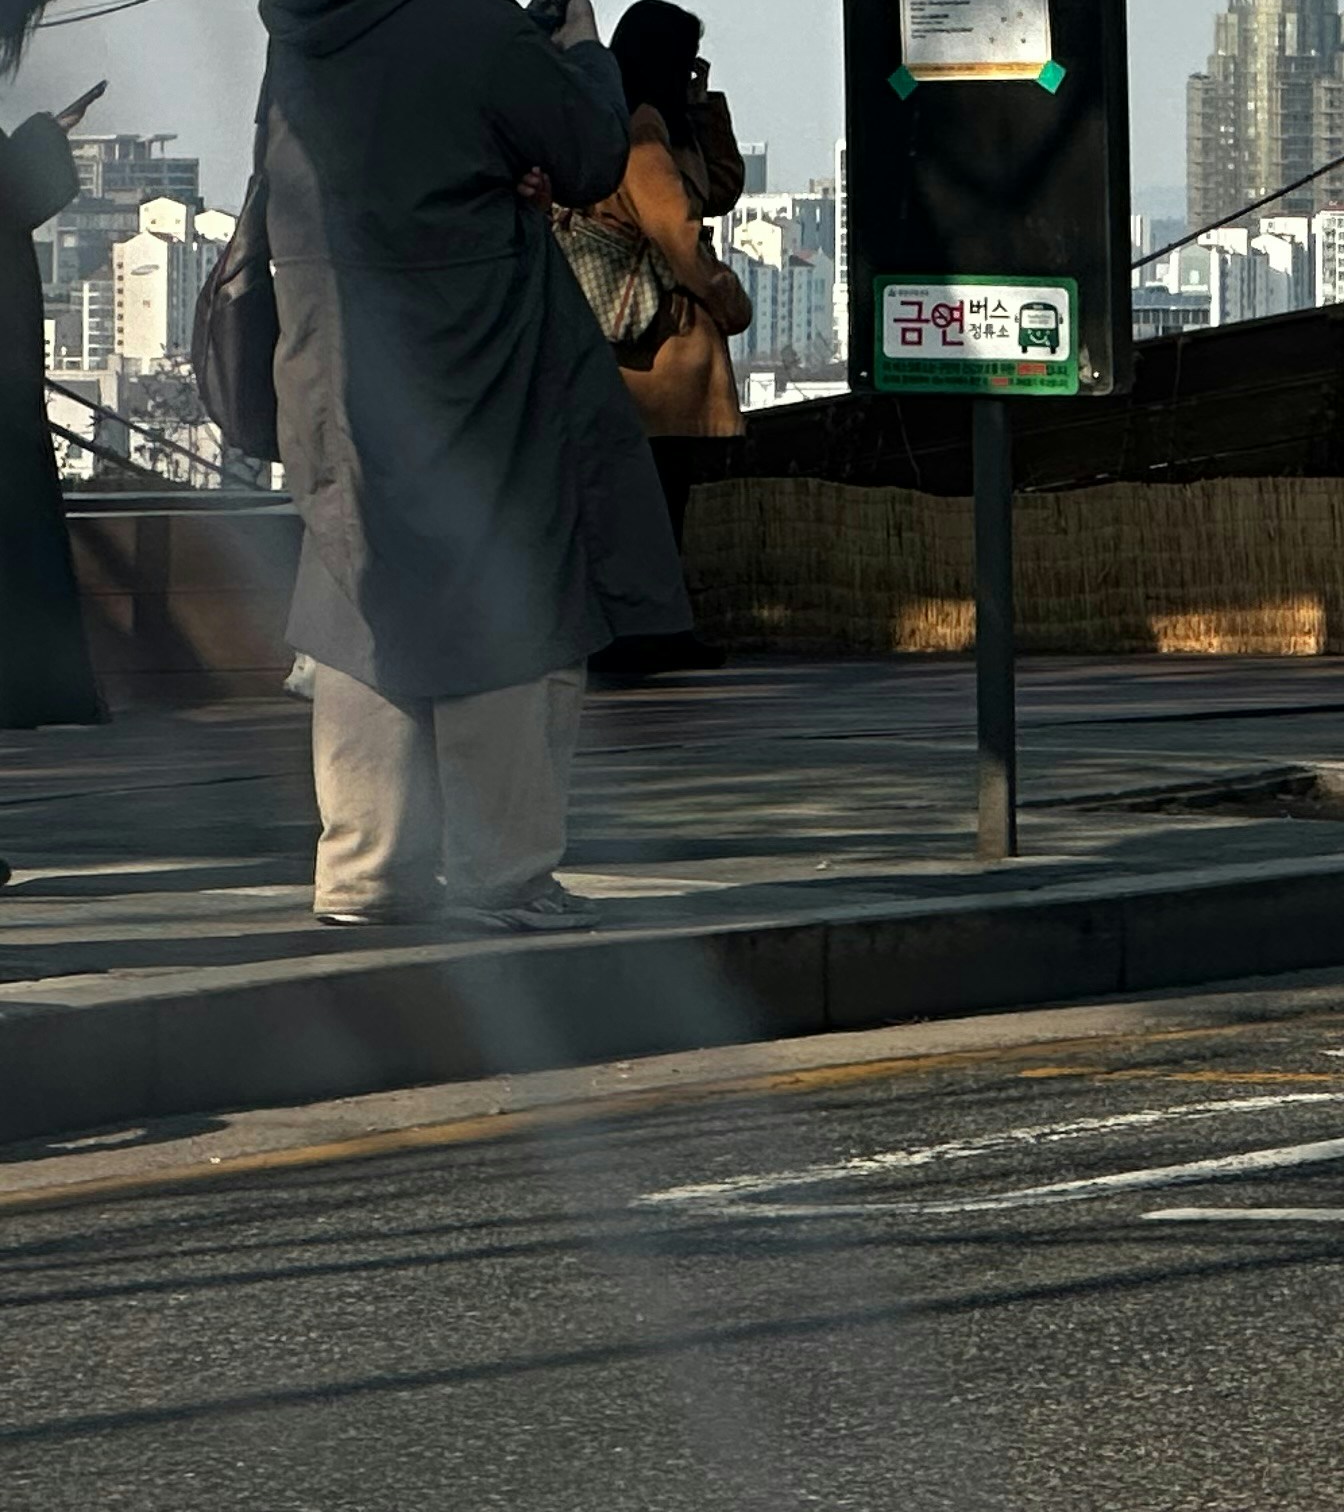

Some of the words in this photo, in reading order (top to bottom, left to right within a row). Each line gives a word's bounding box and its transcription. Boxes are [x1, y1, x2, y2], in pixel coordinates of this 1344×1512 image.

[968, 296, 1011, 322] 버스
[893, 299, 965, 347] 금연
[968, 323, 1010, 341] 정류소
